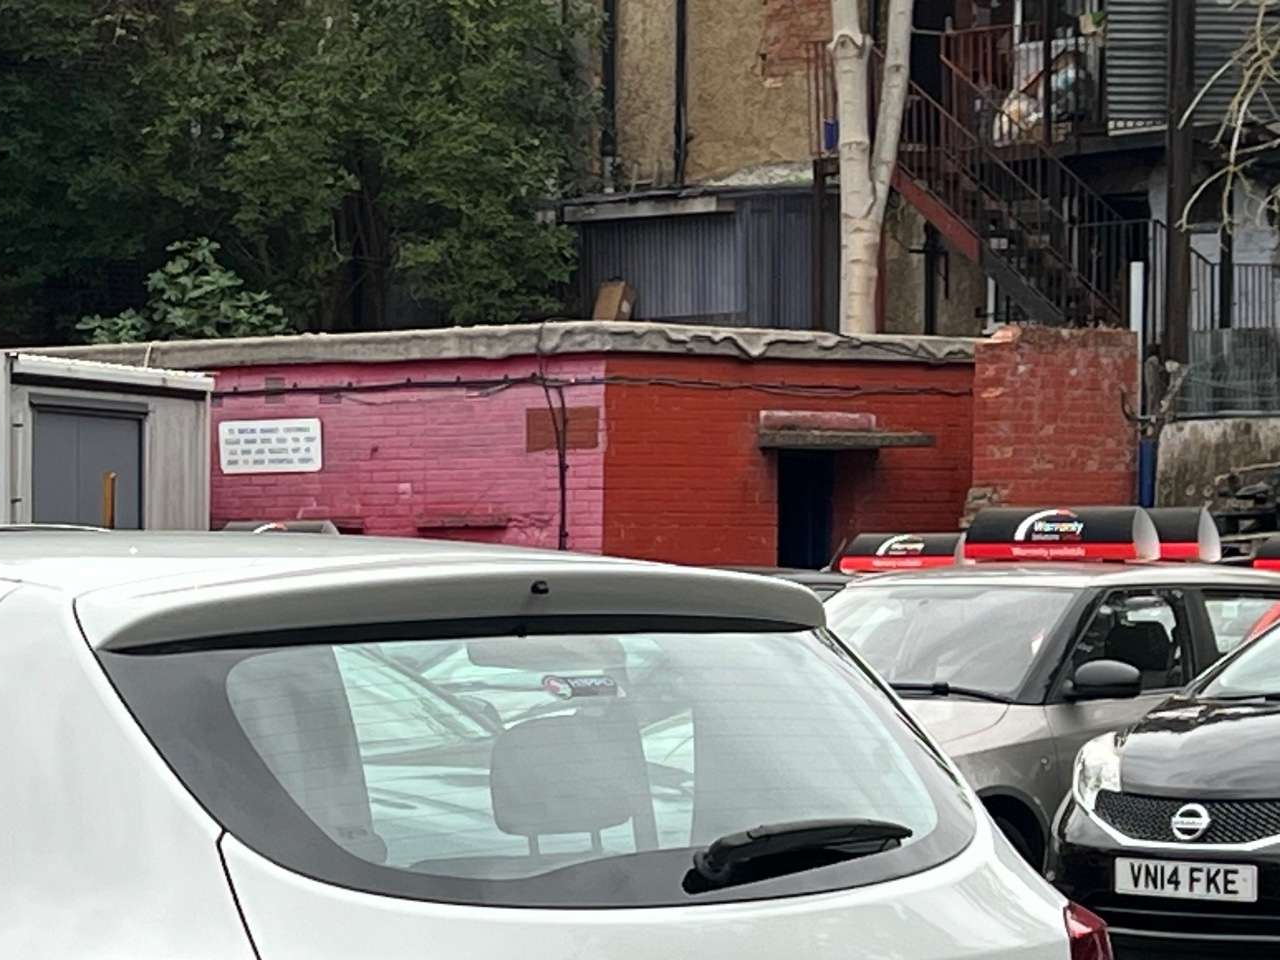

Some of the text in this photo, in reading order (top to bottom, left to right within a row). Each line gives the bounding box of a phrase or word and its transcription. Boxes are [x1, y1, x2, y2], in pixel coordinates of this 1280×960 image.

[1034, 520, 1084, 536] Warranty
[1129, 862, 1240, 895] VN14 FKE
